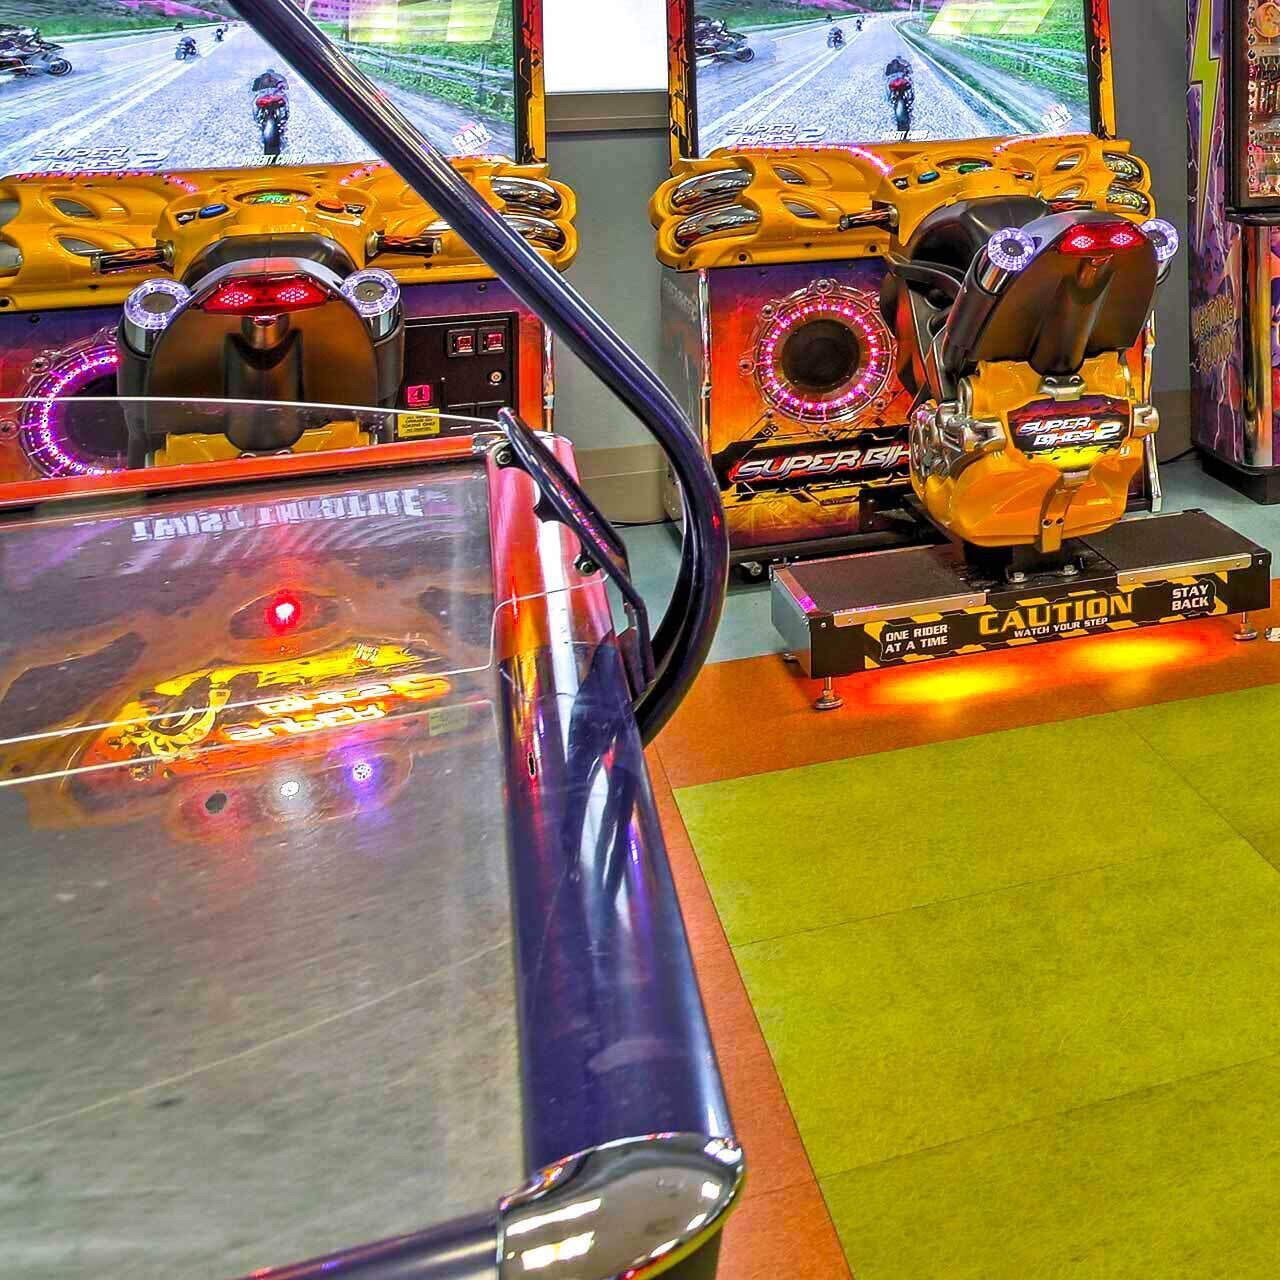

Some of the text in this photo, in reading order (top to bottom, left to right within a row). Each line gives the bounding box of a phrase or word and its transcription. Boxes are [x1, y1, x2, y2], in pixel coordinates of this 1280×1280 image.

[34, 145, 129, 161] SUPER
[1018, 416, 1092, 435] SUPER
[1032, 421, 1122, 447] BIKES 2
[731, 447, 861, 482] SUPER
[1172, 584, 1209, 599] STAY
[1172, 596, 1210, 611] BACK
[978, 593, 1133, 636] CAUTION
[885, 624, 948, 642] ONE RIDER
[1014, 617, 1108, 638] WATCH YOUR STEP
[884, 635, 948, 654] AT A TIME
